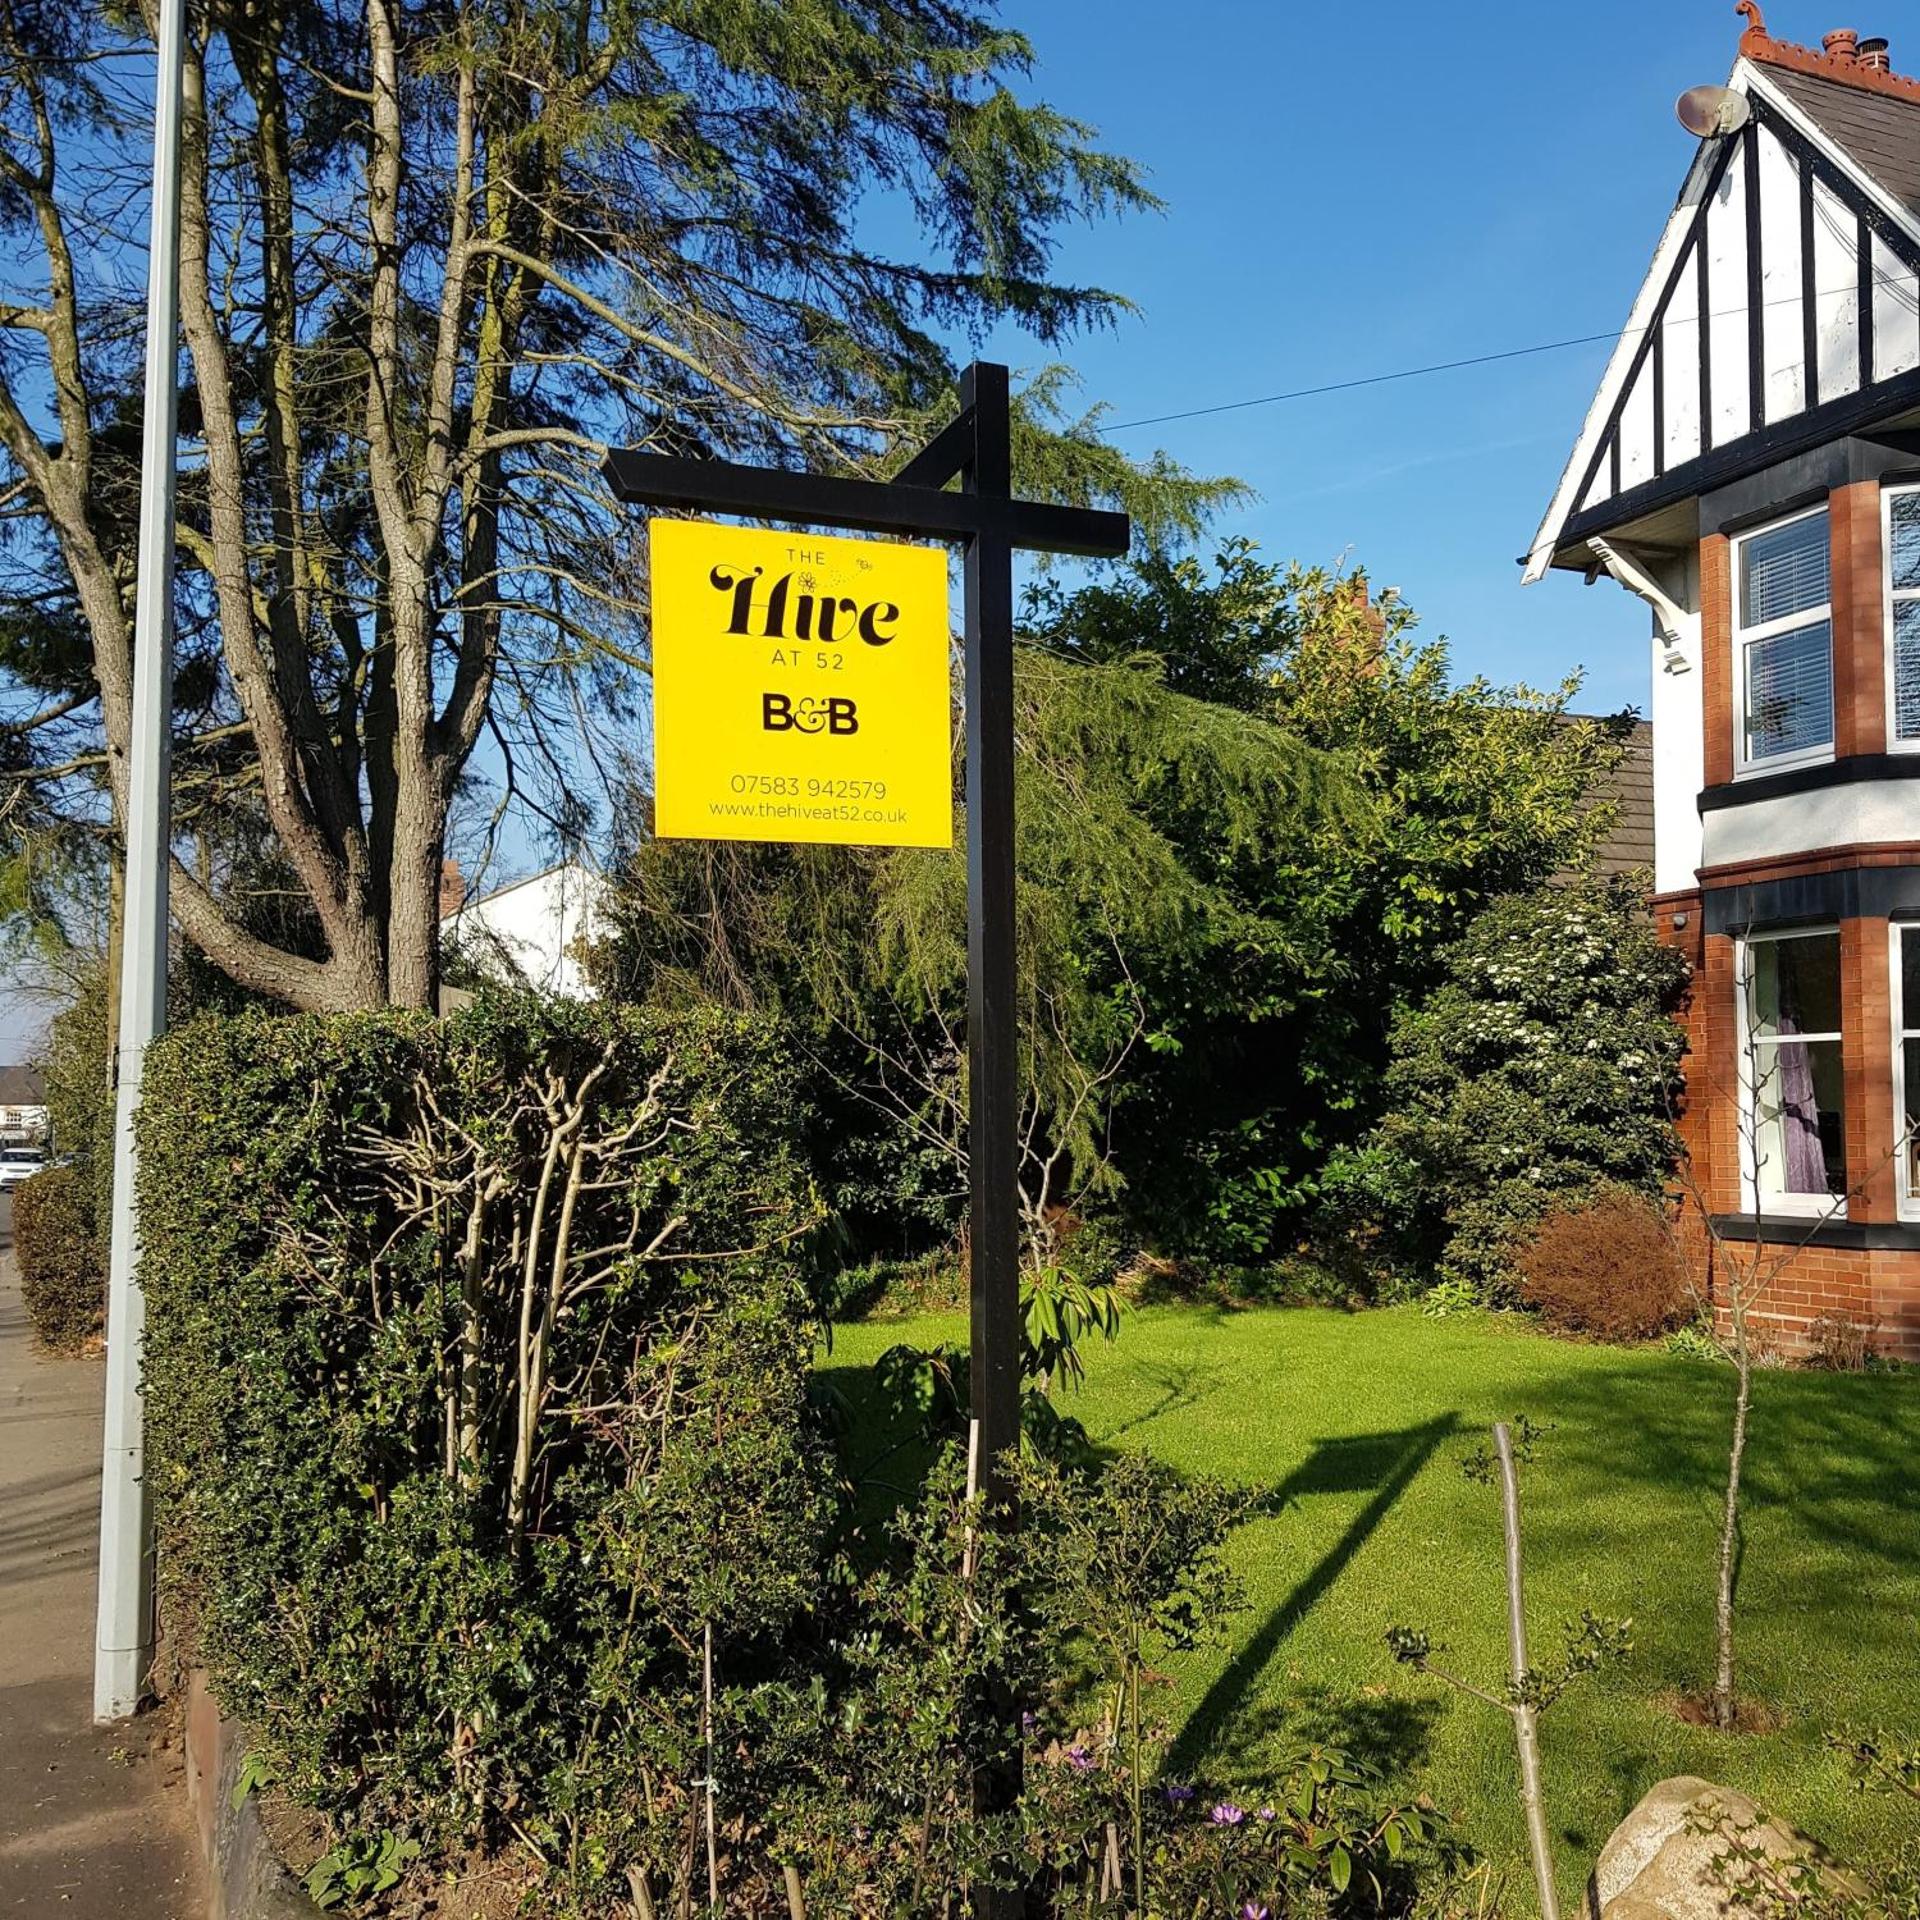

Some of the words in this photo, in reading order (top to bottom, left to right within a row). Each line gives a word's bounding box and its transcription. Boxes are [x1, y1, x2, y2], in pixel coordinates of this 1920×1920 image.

[786, 548, 826, 565] THE
[709, 563, 900, 647] Hive
[771, 649, 801, 667] AT
[816, 652, 844, 670] 52
[762, 692, 859, 735] B&B
[730, 774, 800, 796] 07583
[807, 778, 887, 800] 942579
[709, 801, 908, 824] www.thehiveat52.co.uk
